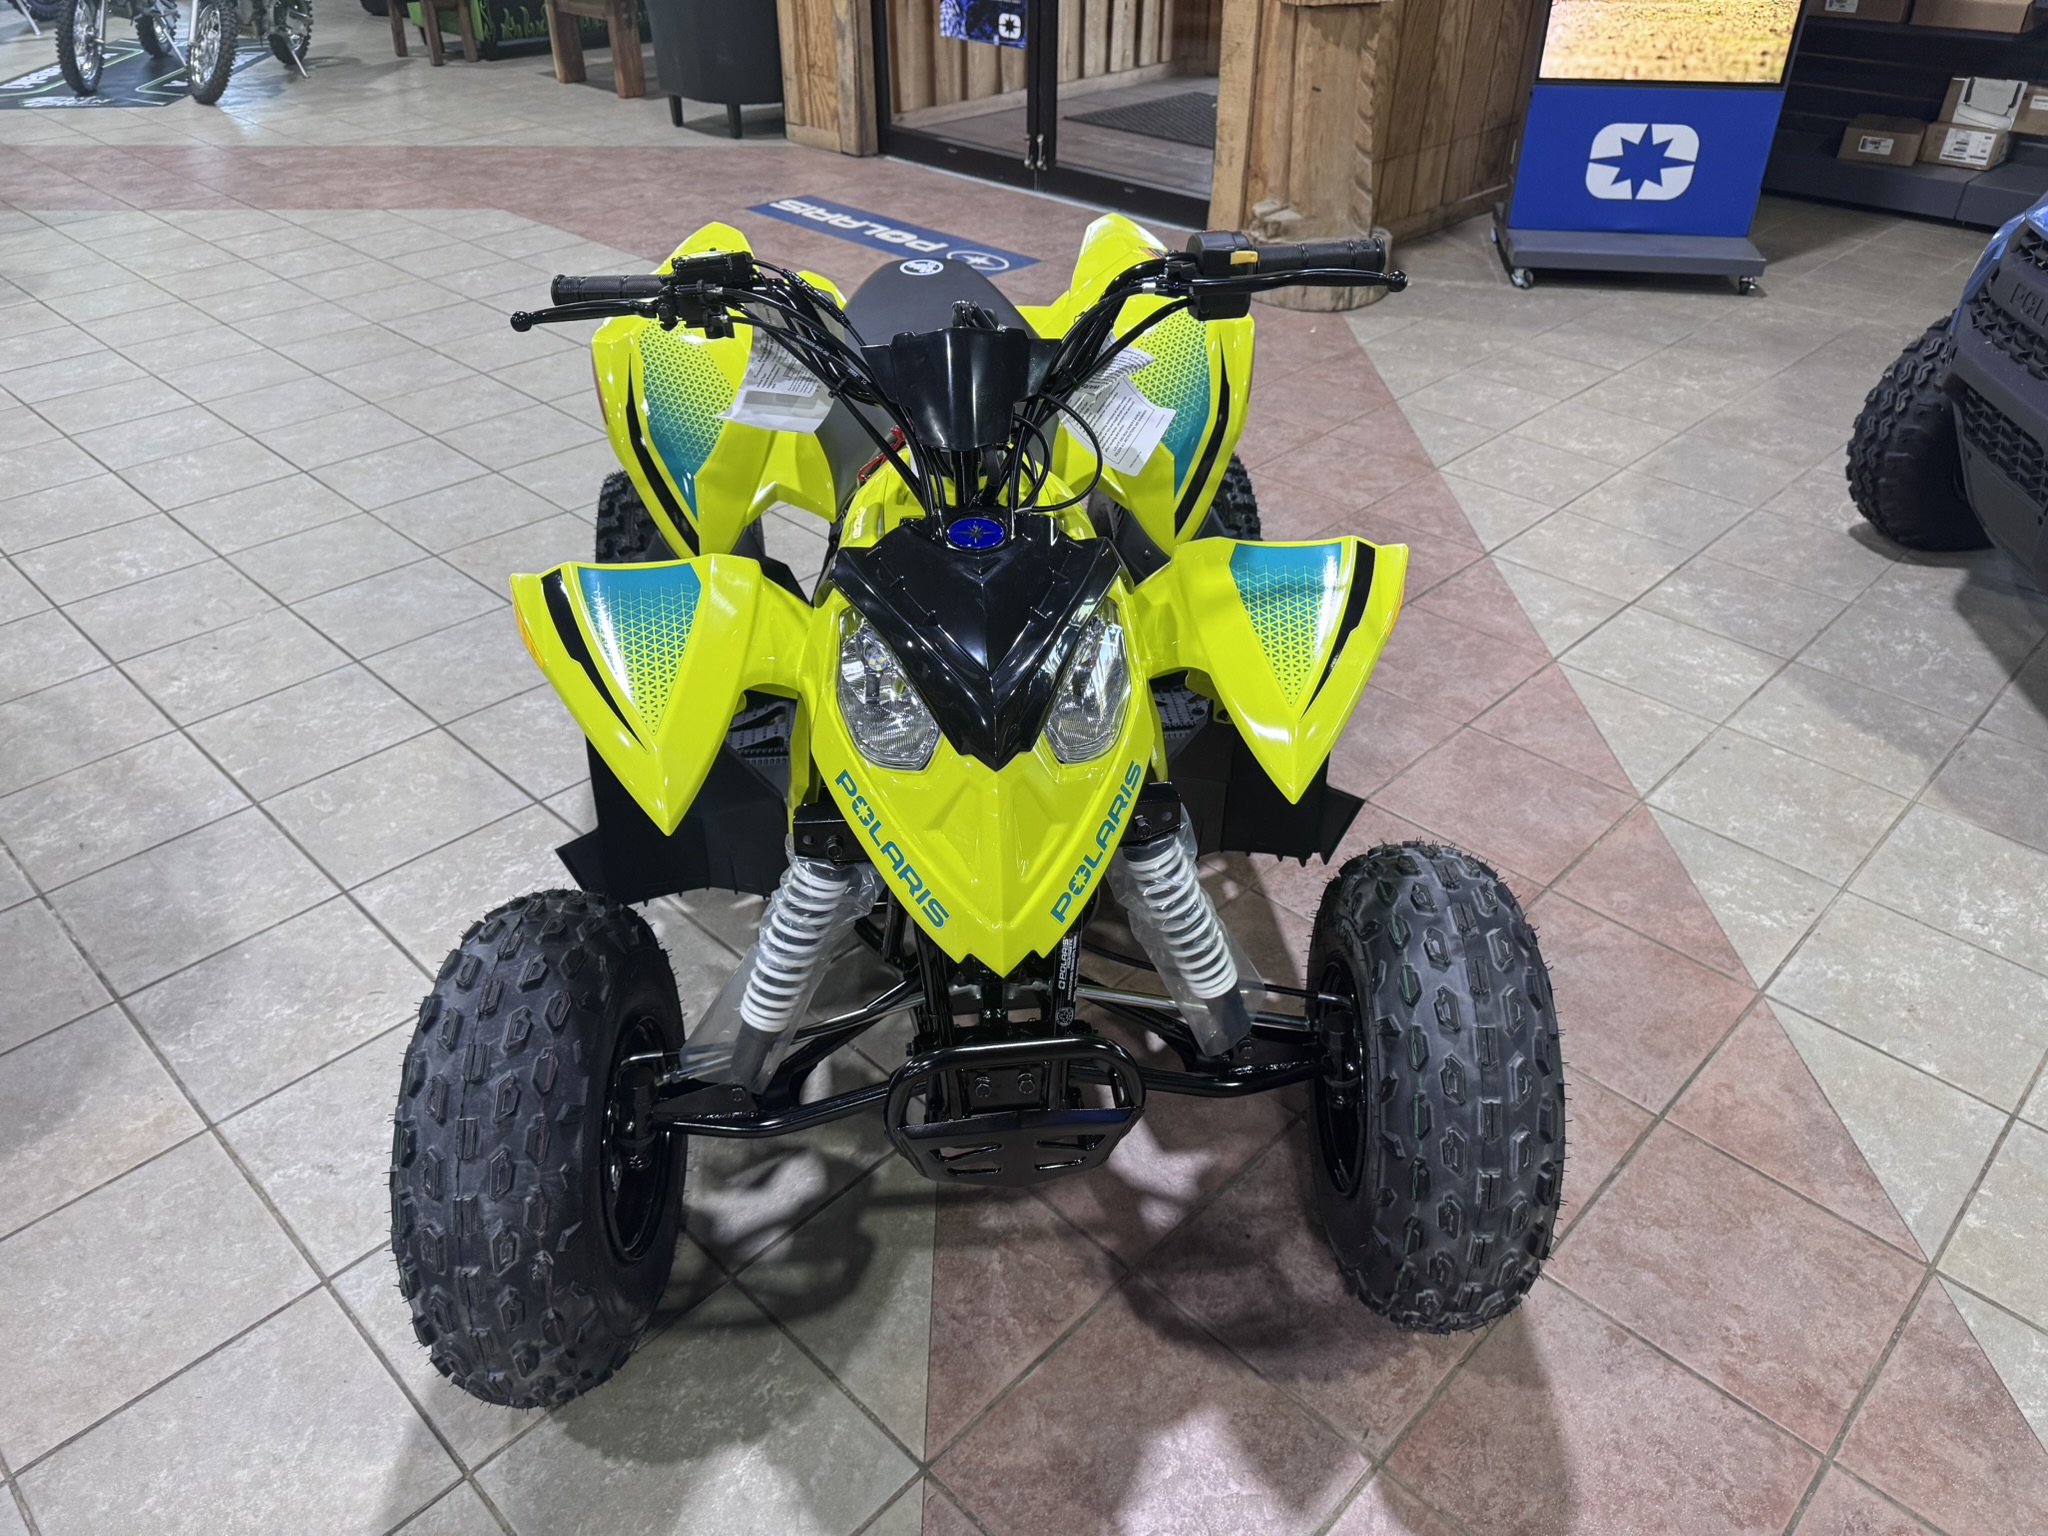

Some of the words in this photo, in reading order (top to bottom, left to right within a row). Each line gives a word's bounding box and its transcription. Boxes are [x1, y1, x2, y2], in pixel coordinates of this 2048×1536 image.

[769, 198, 949, 253] POLARIS
[835, 769, 950, 929] POLARIS
[1049, 761, 1142, 924] POLARIS
[1060, 937, 1068, 981] POLARIS
